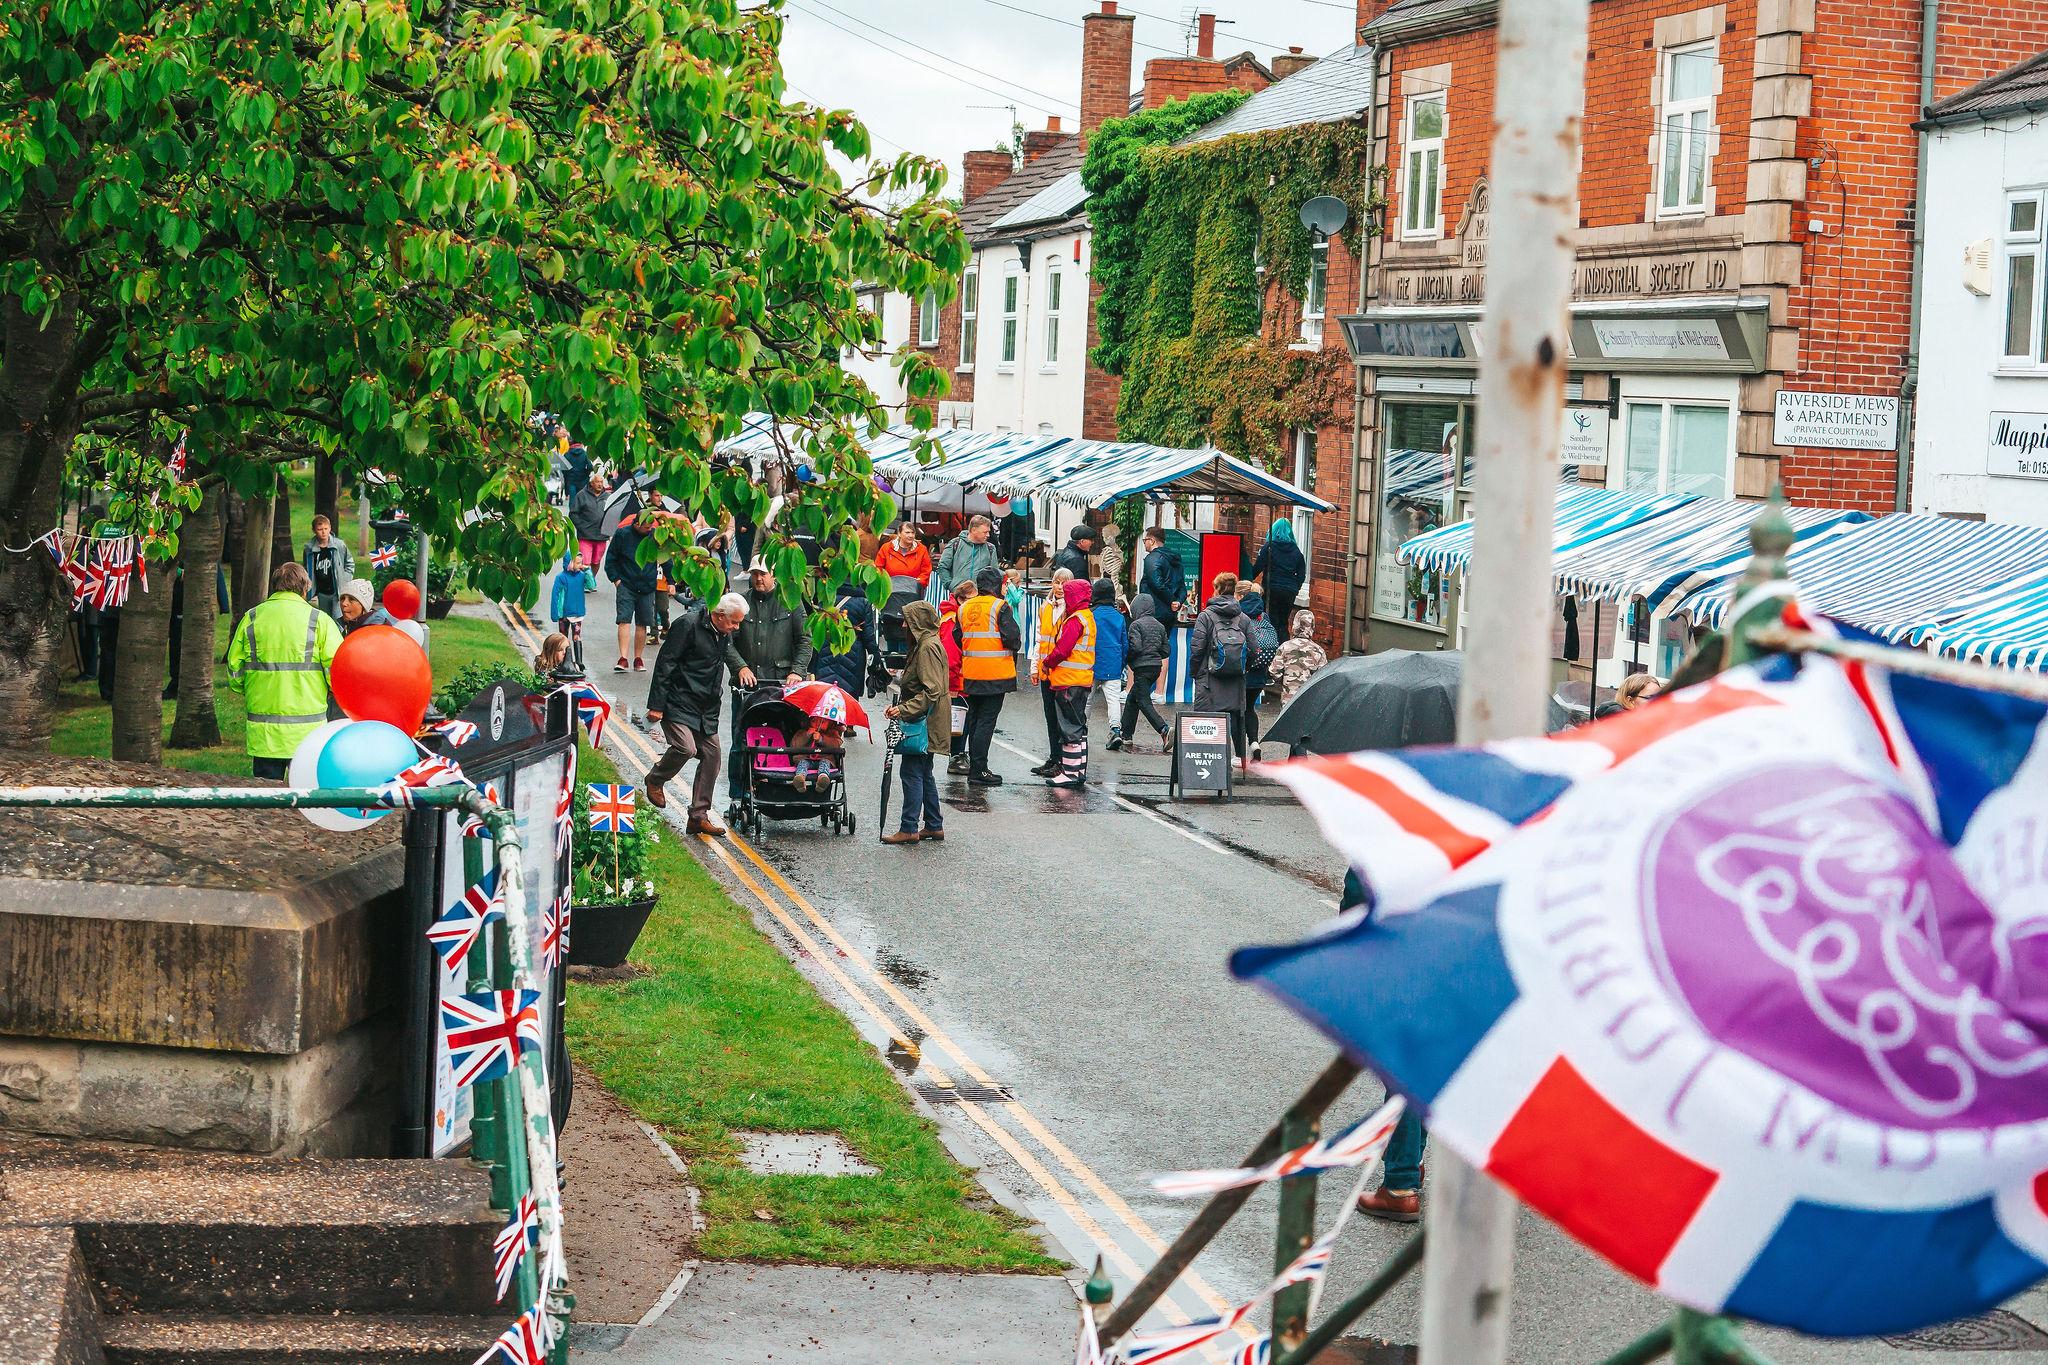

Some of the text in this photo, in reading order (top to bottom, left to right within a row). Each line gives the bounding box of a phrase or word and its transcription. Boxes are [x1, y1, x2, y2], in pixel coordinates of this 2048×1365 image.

[1467, 243, 1488, 263] BRAN
[1584, 265, 1641, 295] INDUSTRIAL
[1650, 260, 1695, 292] SOCIETY
[1706, 259, 1727, 289] LTD
[1416, 275, 1453, 300] LINCOLN
[1461, 274, 1485, 299] EQUIT
[1677, 331, 1684, 346] &
[1780, 393, 1895, 412] RIVERSIDE MEWS
[1785, 409, 1888, 427] & APARTMENTS
[1793, 425, 1879, 438] (PRIVATE COURTYARD)
[1991, 418, 2048, 455] Magpi
[1784, 435, 1887, 448] NO PARKING NO TURNING
[2018, 460, 2048, 474] Tel: 015
[1203, 752, 1222, 760] THIS
